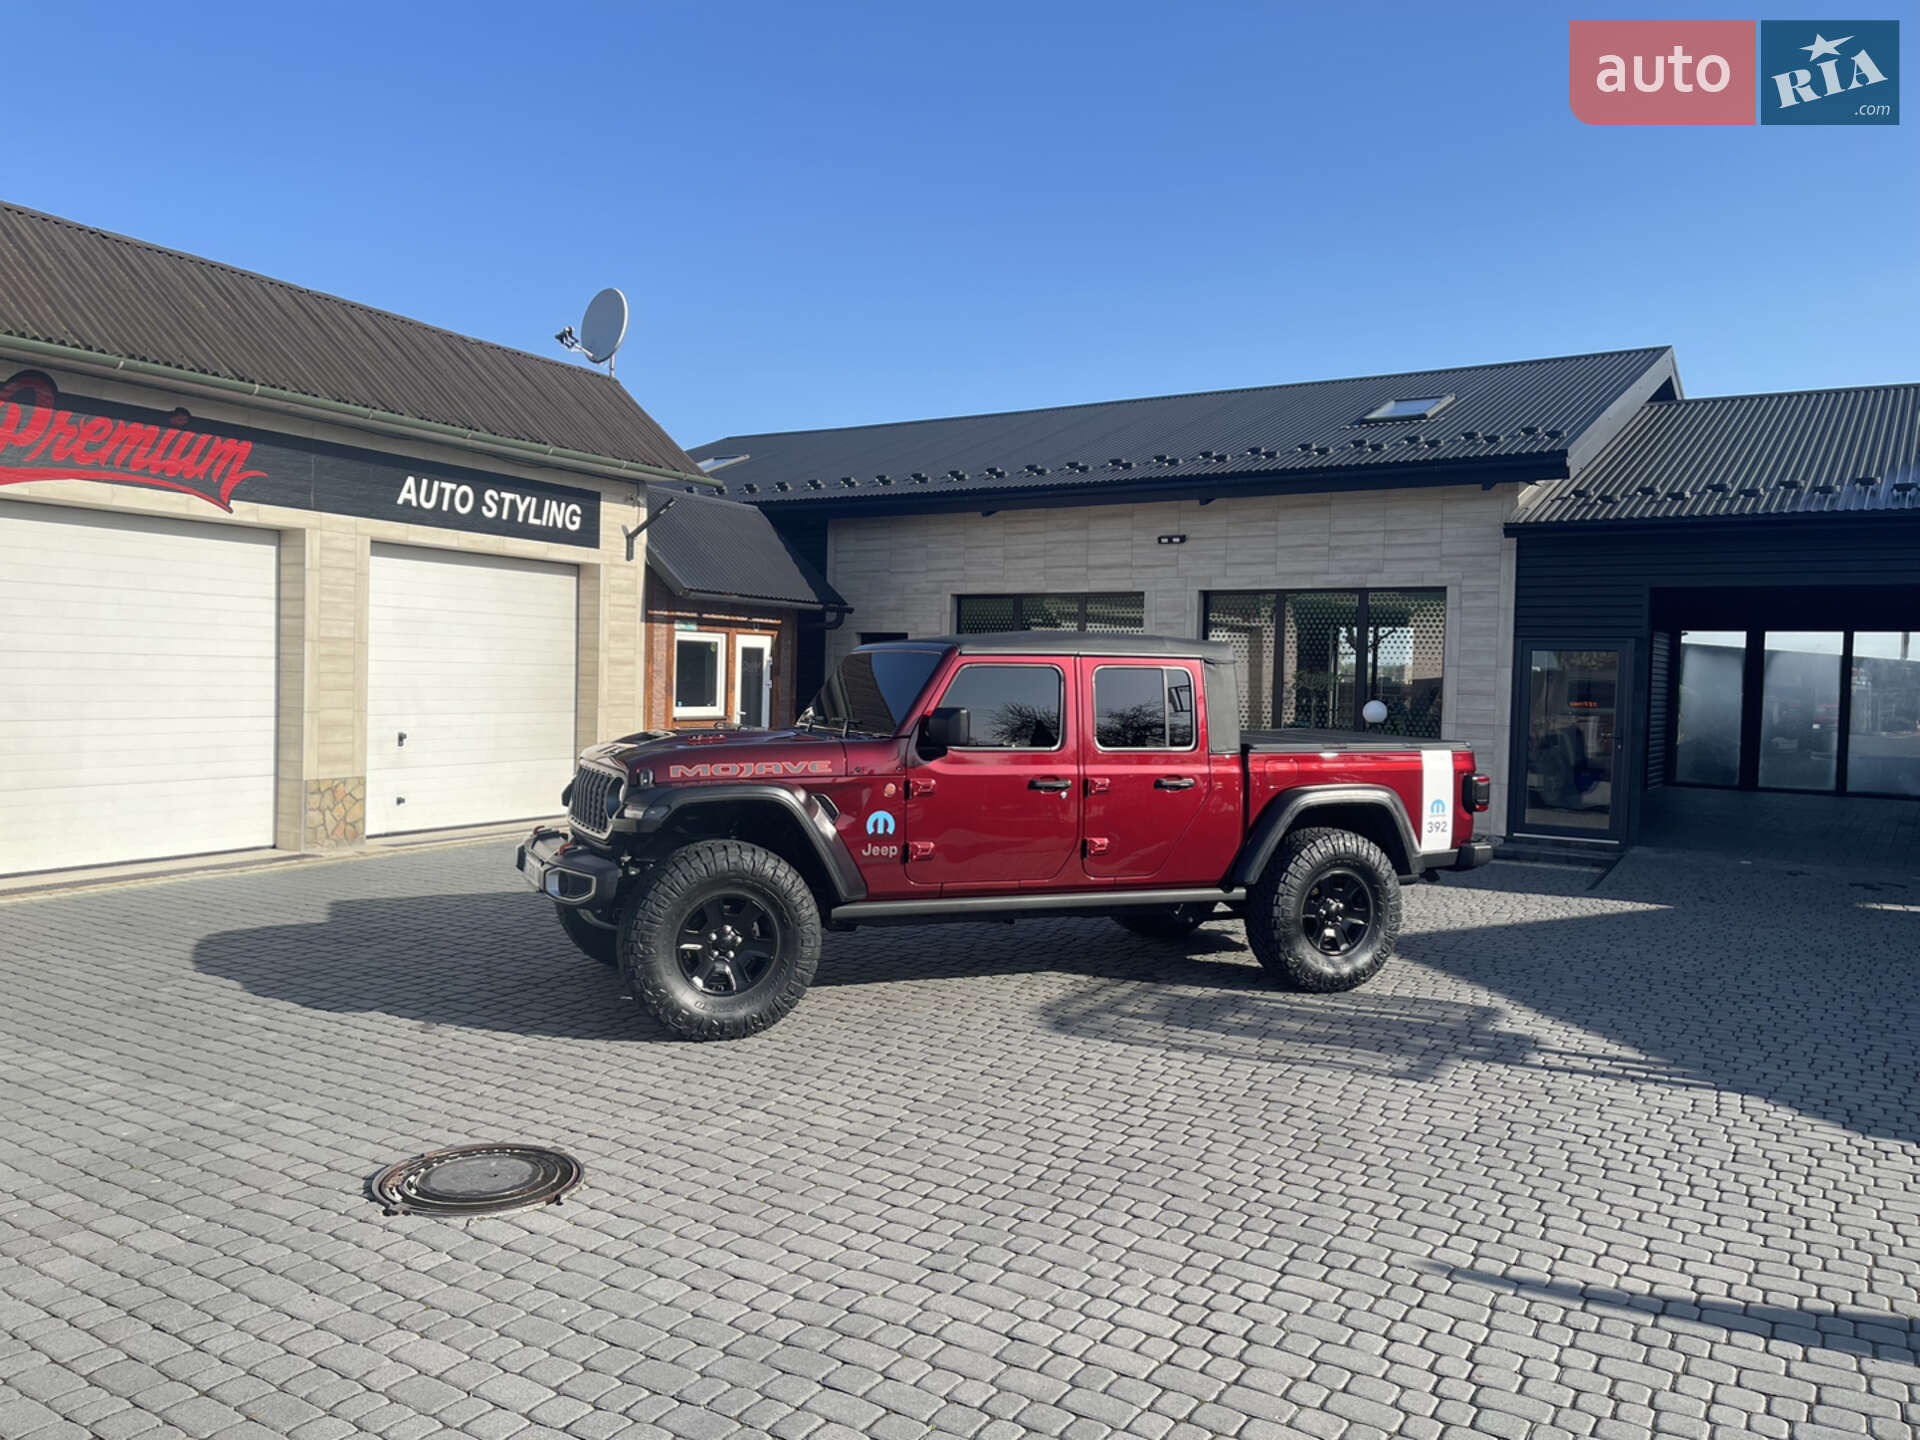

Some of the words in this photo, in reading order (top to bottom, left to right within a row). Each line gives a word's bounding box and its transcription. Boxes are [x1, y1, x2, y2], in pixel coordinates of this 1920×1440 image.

[0, 377, 268, 504] Premium
[397, 475, 474, 515] AUTO
[481, 488, 582, 532] STYLING
[669, 760, 833, 778] MOJAVE
[1426, 820, 1448, 834] 392
[861, 843, 898, 858] Jeep
